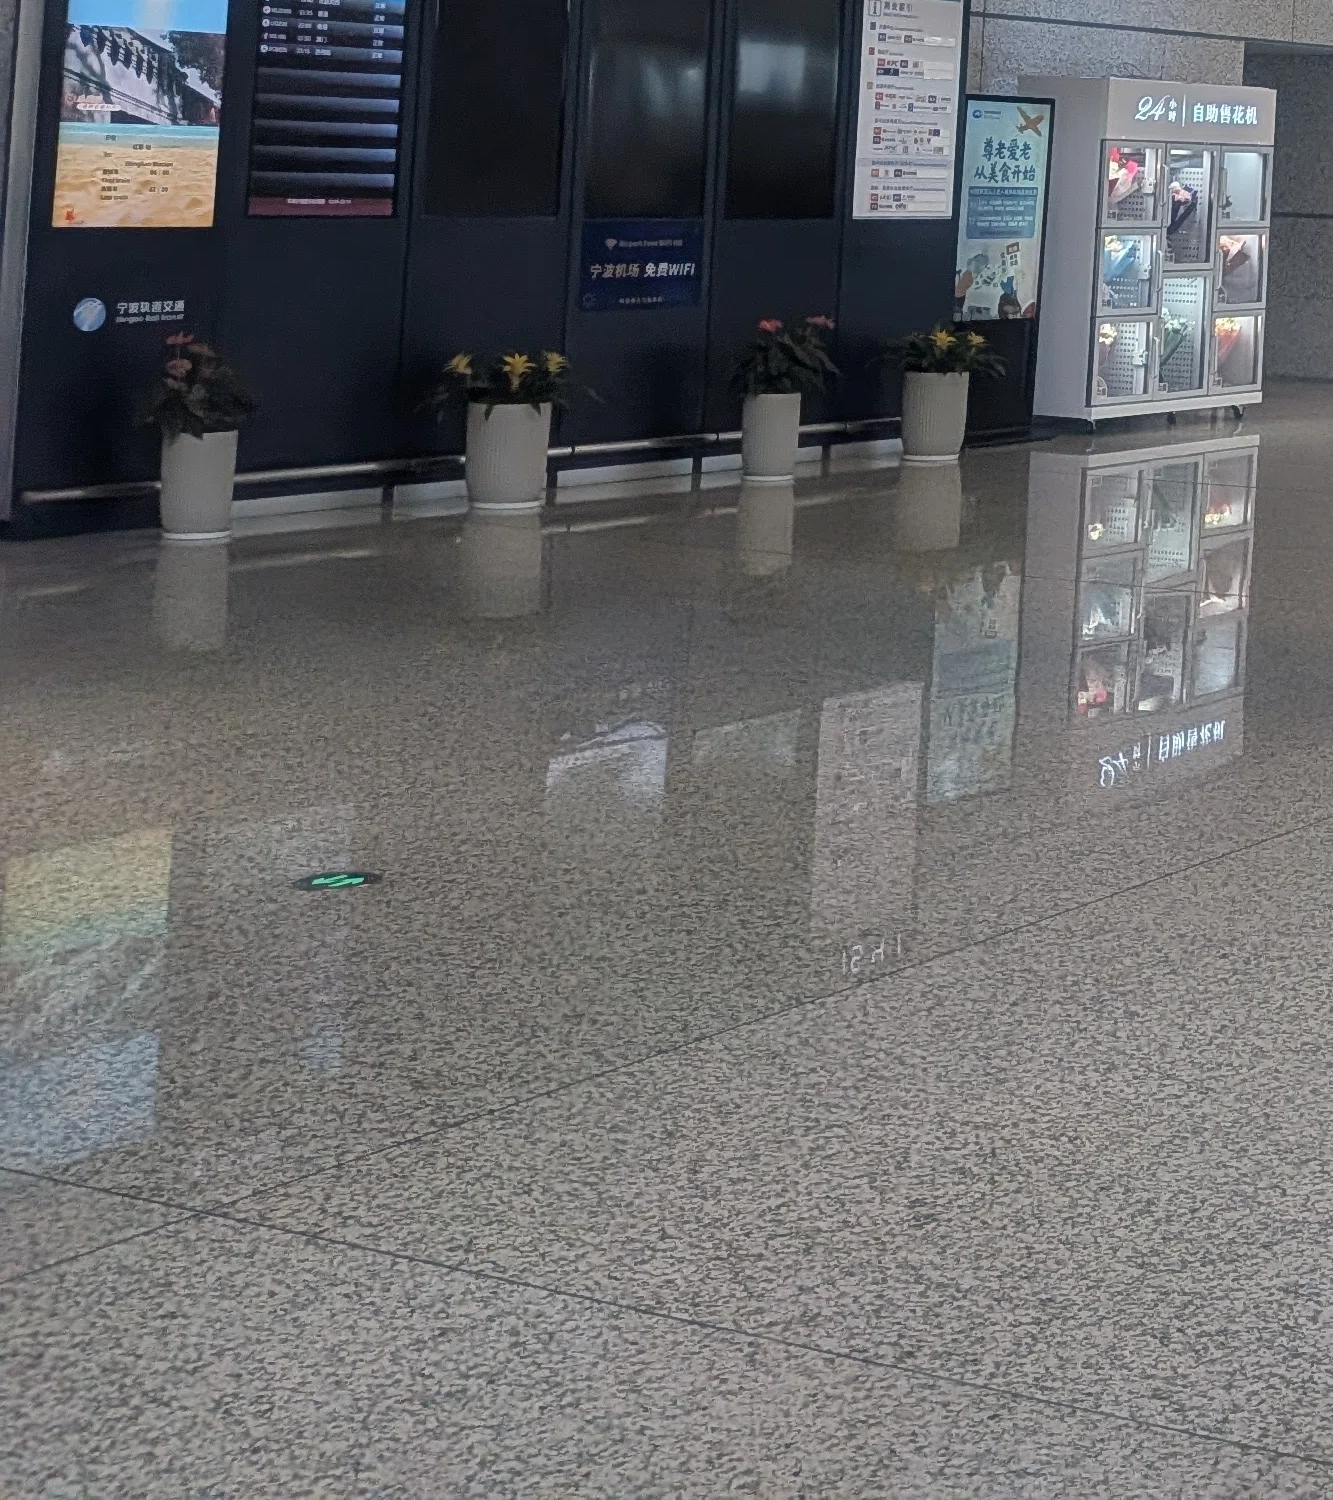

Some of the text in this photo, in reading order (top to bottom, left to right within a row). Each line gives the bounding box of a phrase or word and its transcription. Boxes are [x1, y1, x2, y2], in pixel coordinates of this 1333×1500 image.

[1193, 103, 1258, 125] 自助售花机
[974, 162, 1036, 184] 从美食开始
[590, 263, 640, 279] 宁波机场
